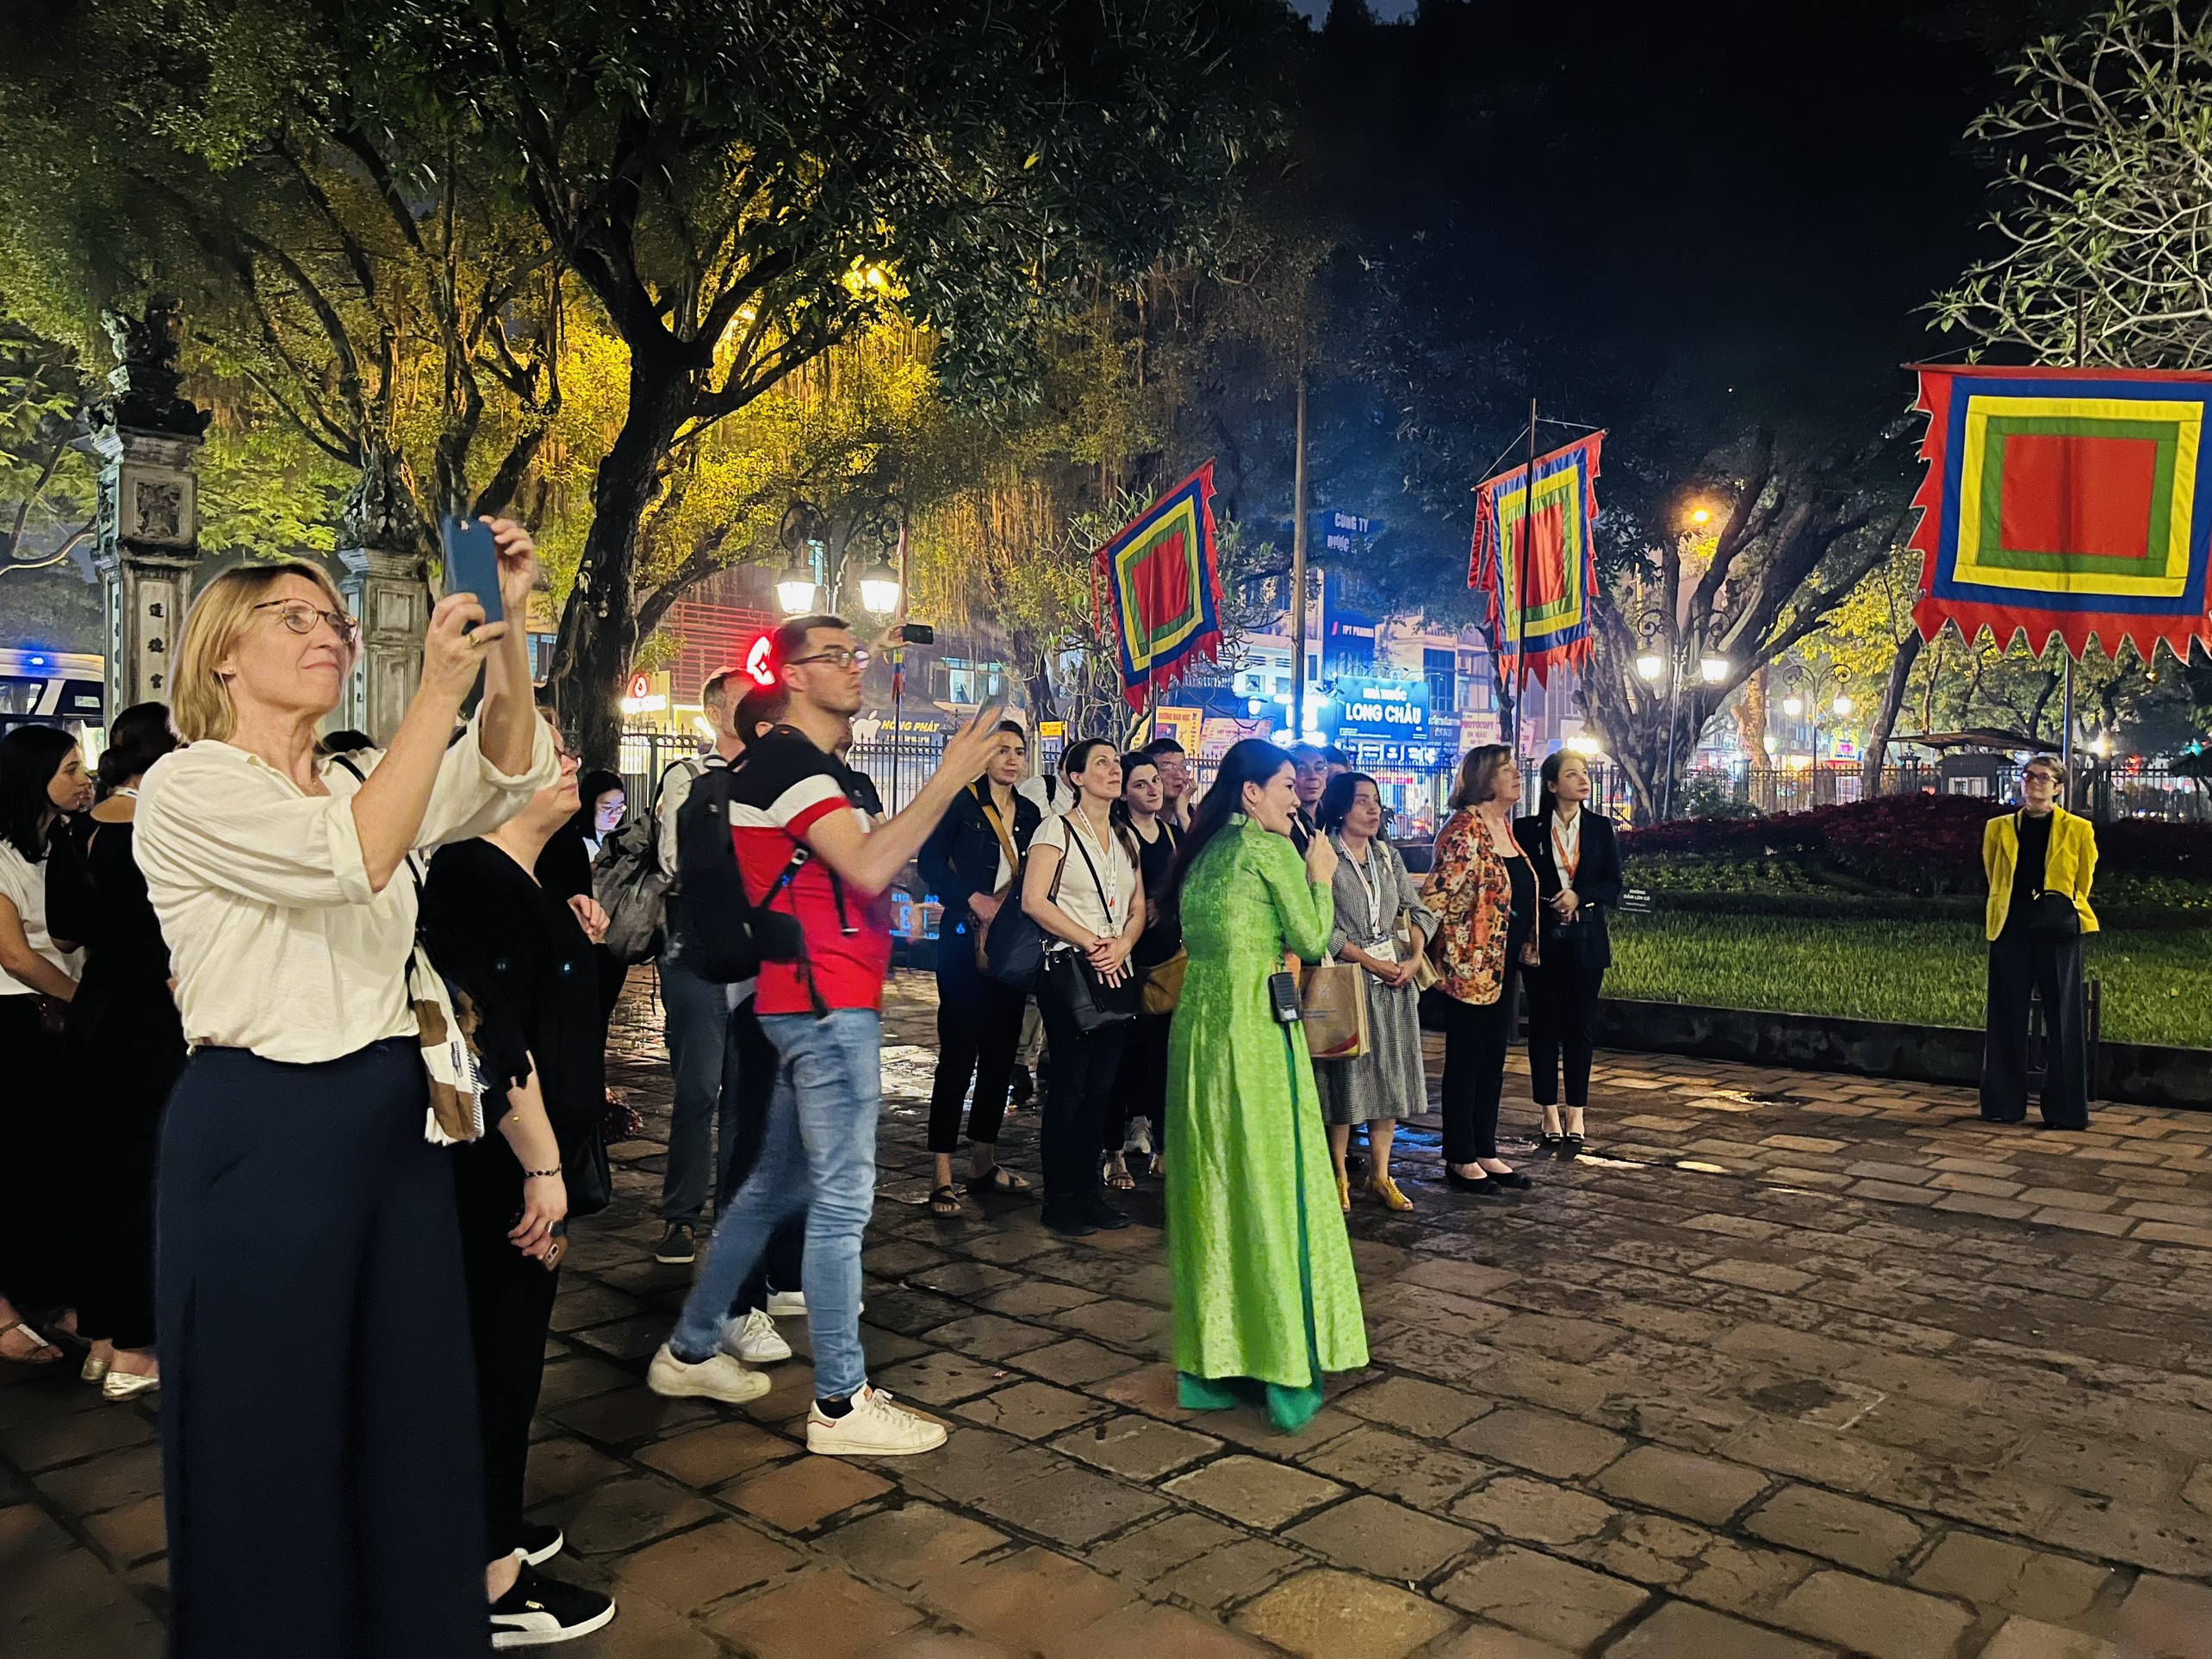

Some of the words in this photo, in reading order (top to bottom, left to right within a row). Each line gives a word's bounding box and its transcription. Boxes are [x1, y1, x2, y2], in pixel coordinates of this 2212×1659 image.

[1358, 518, 1369, 532] TY
[1345, 702, 1383, 723] LONG
[1384, 702, 1421, 724] CHÂU
[913, 720, 941, 733] PHÁT
